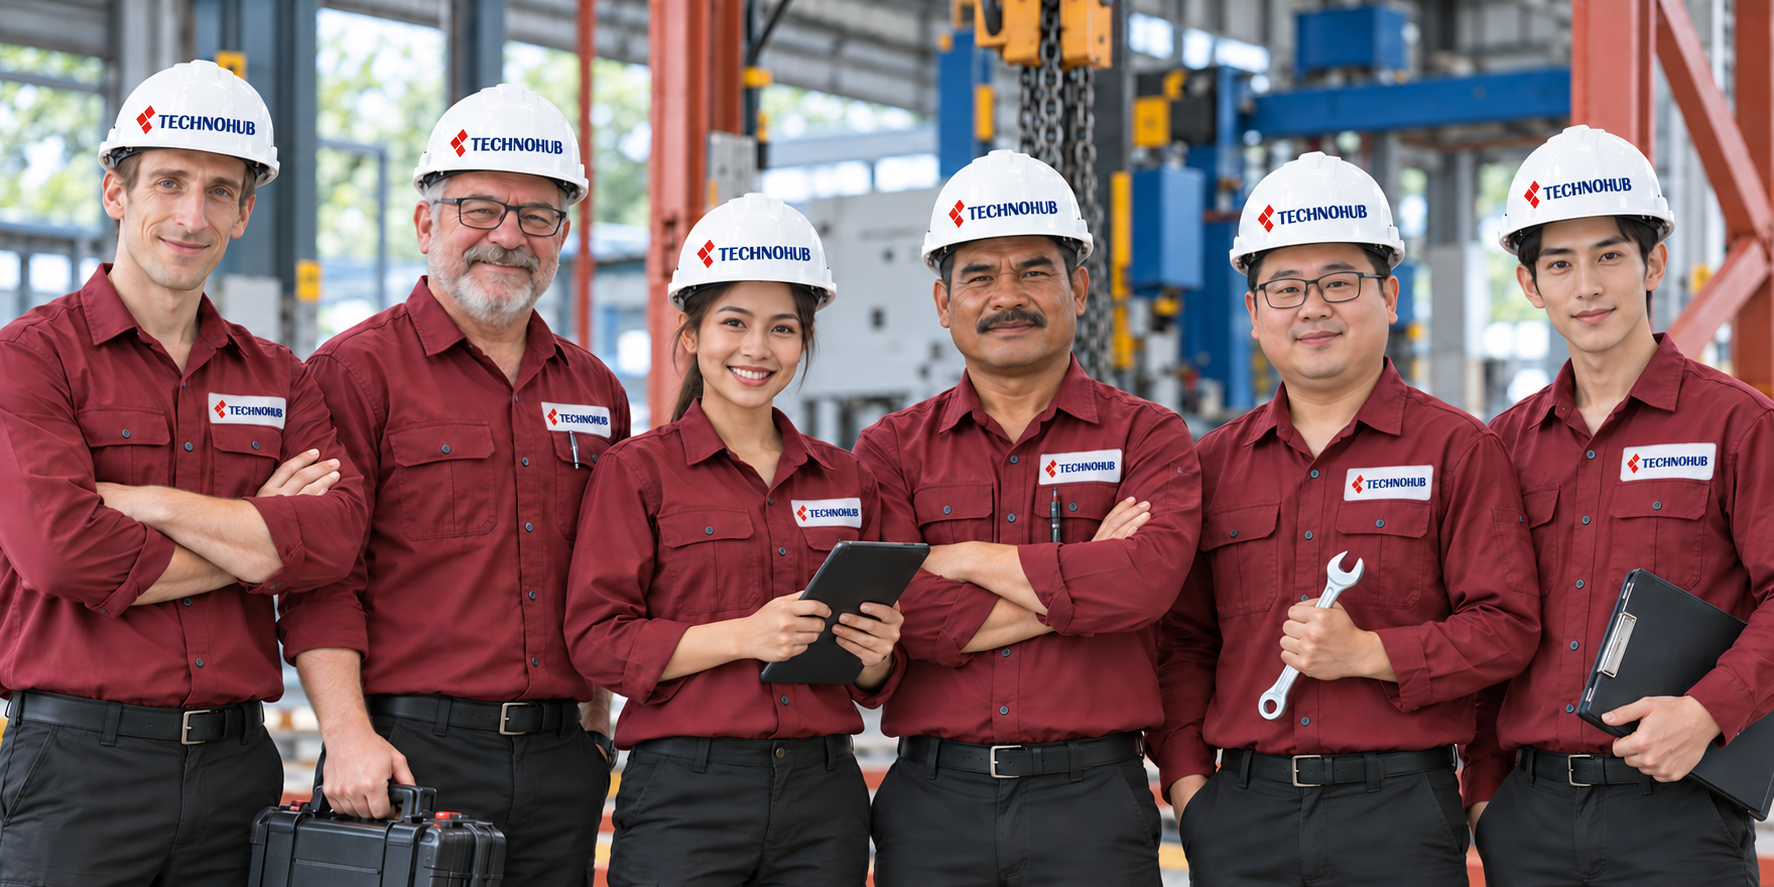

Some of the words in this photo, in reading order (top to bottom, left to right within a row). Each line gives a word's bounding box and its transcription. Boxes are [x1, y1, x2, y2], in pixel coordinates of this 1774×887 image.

[158, 114, 256, 136] TECHNOHUB
[470, 137, 563, 155] TECHNOHUB
[1543, 178, 1632, 201] TECHNOHUB
[967, 201, 1058, 221] TECHNOHUB
[1276, 205, 1368, 225] TECHNOHUB
[718, 245, 811, 262] TECHNOHUB
[228, 405, 283, 418] TECHNOHUB
[559, 413, 608, 426] TECHNOHUB
[1059, 460, 1115, 473] TECHNOHUB
[1642, 456, 1708, 468] TECHNOHUB
[1366, 477, 1427, 489] TECHNOHUB
[809, 507, 859, 518] TECHNOHUB
